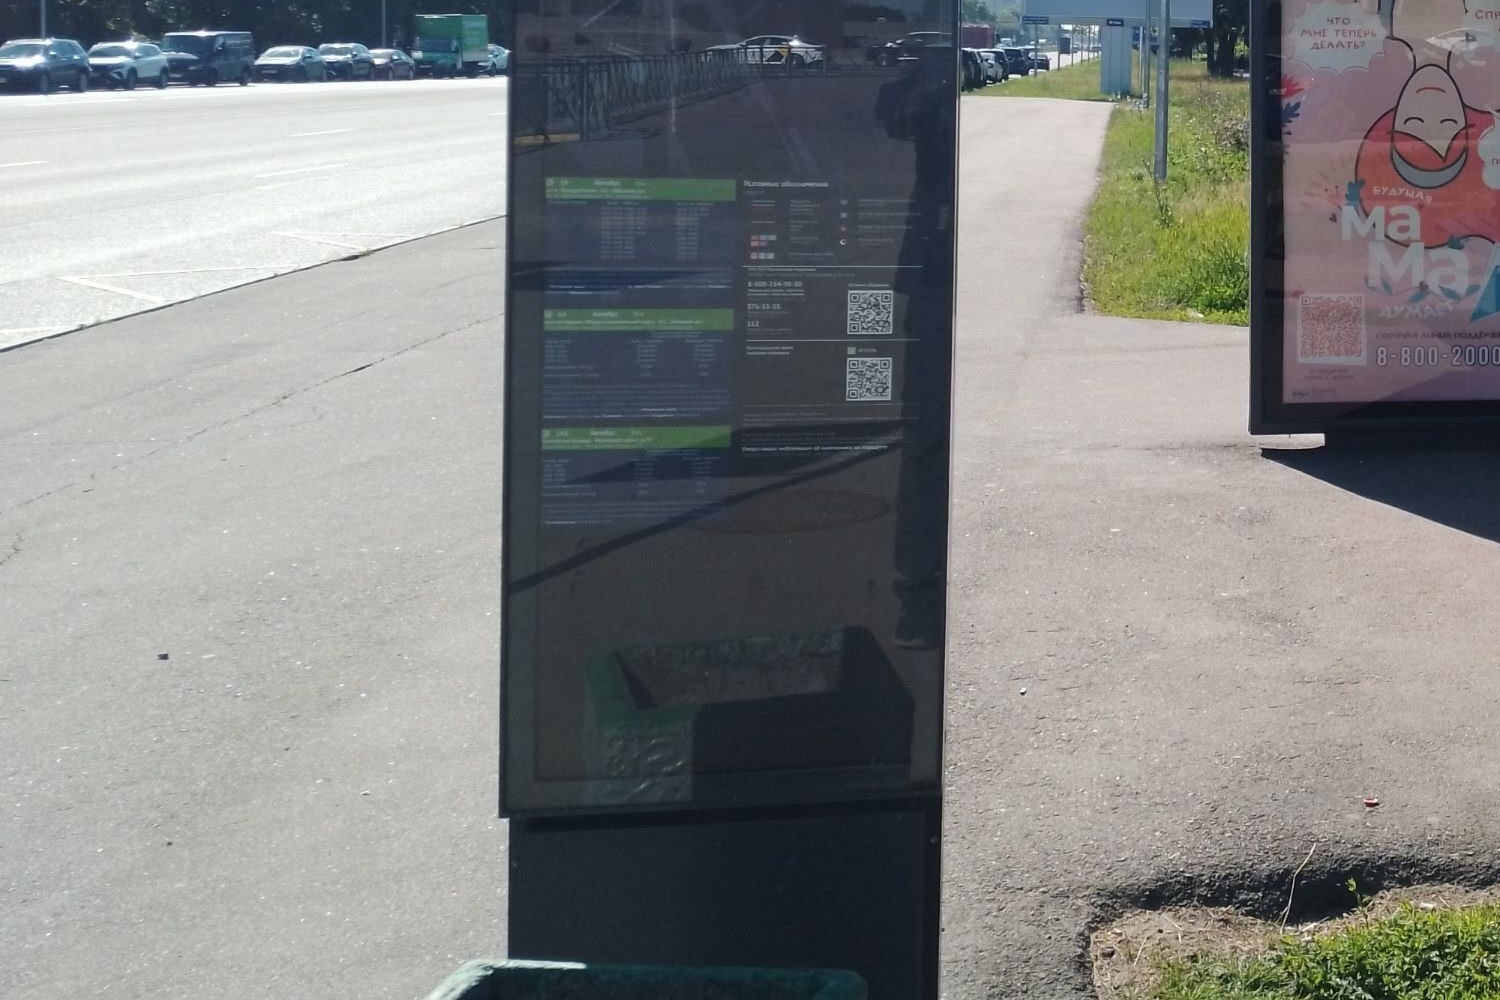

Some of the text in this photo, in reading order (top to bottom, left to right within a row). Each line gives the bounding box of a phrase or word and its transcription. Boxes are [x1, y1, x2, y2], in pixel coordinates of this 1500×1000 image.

[1326, 16, 1351, 26] ЧТО
[1300, 28, 1377, 38] МНЕ ТЕПЕРЬ
[1310, 40, 1366, 50] ДЕЛАТЬ?
